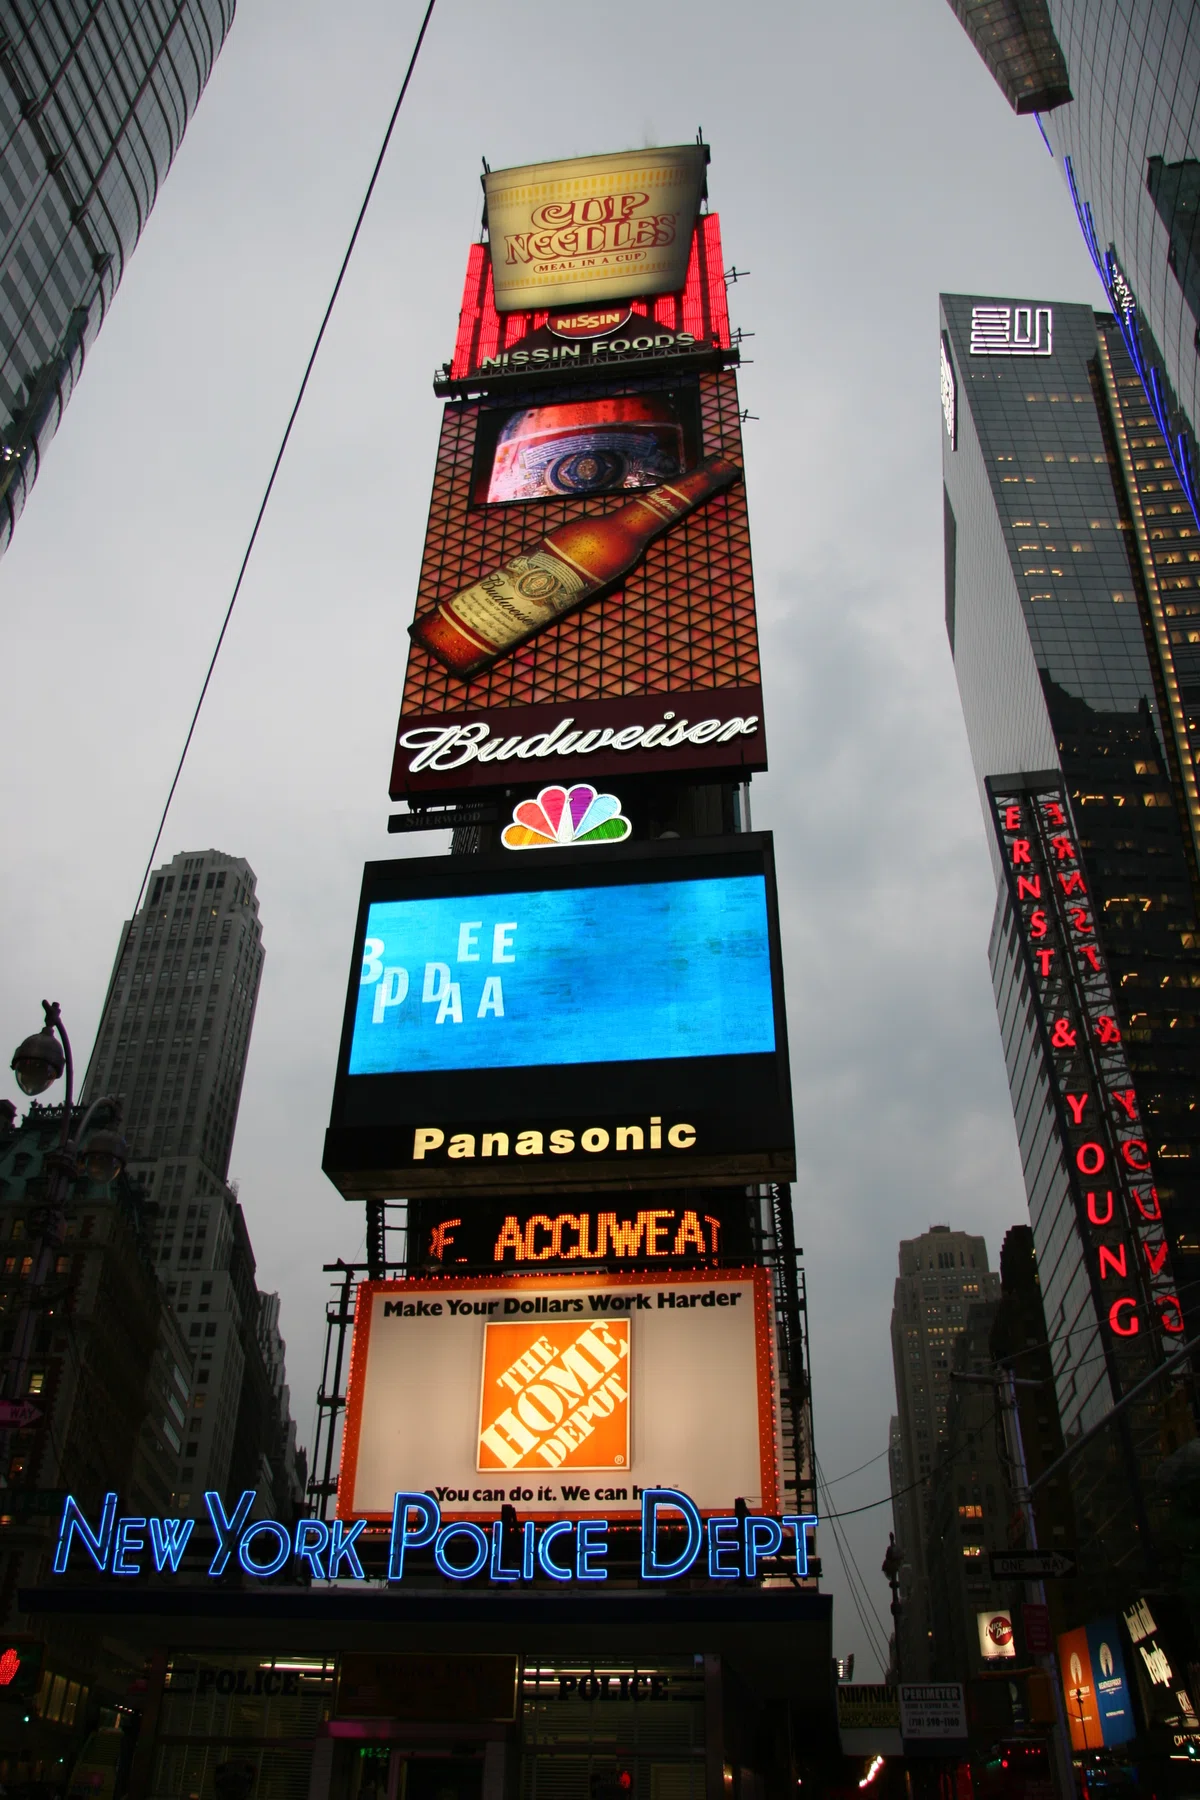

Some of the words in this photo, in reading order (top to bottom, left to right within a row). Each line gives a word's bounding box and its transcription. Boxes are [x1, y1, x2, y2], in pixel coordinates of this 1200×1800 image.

[531, 191, 650, 231] CUP
[504, 213, 677, 265] NOODLES
[539, 260, 575, 272] MEAL
[582, 258, 595, 266] IN
[602, 256, 609, 264] A
[615, 252, 642, 263] CUP
[556, 312, 620, 331] NISSIN
[481, 344, 581, 369] NISSIN
[592, 332, 695, 354] FOODS
[480, 573, 535, 627] Budweiser
[400, 711, 760, 773] Budweiser
[1004, 805, 1055, 977] ERNST
[1051, 1018, 1077, 1048] &
[1066, 1093, 1140, 1337] YOUNG
[412, 1117, 697, 1160] Panasonic
[384, 1301, 444, 1317] Make
[447, 1299, 498, 1316] Your
[503, 1296, 583, 1314] Dollars
[588, 1294, 652, 1311] Work
[657, 1290, 742, 1309] Harder
[496, 1335, 560, 1392] THE
[10, 1407, 35, 1419] WAY
[480, 1320, 631, 1470] HOME
[536, 1373, 630, 1469] DEPOT
[435, 1487, 469, 1502] You
[472, 1489, 505, 1501] can
[509, 1487, 533, 1501] do
[537, 1486, 557, 1500] it.
[561, 1486, 591, 1501] We
[594, 1487, 628, 1500] can
[1001, 1561, 1026, 1571] ONE
[1041, 1559, 1066, 1570] WAY
[200, 1669, 299, 1696] POLICE
[558, 1675, 669, 1701] POLICE
[903, 1687, 960, 1700] PERIMETER
